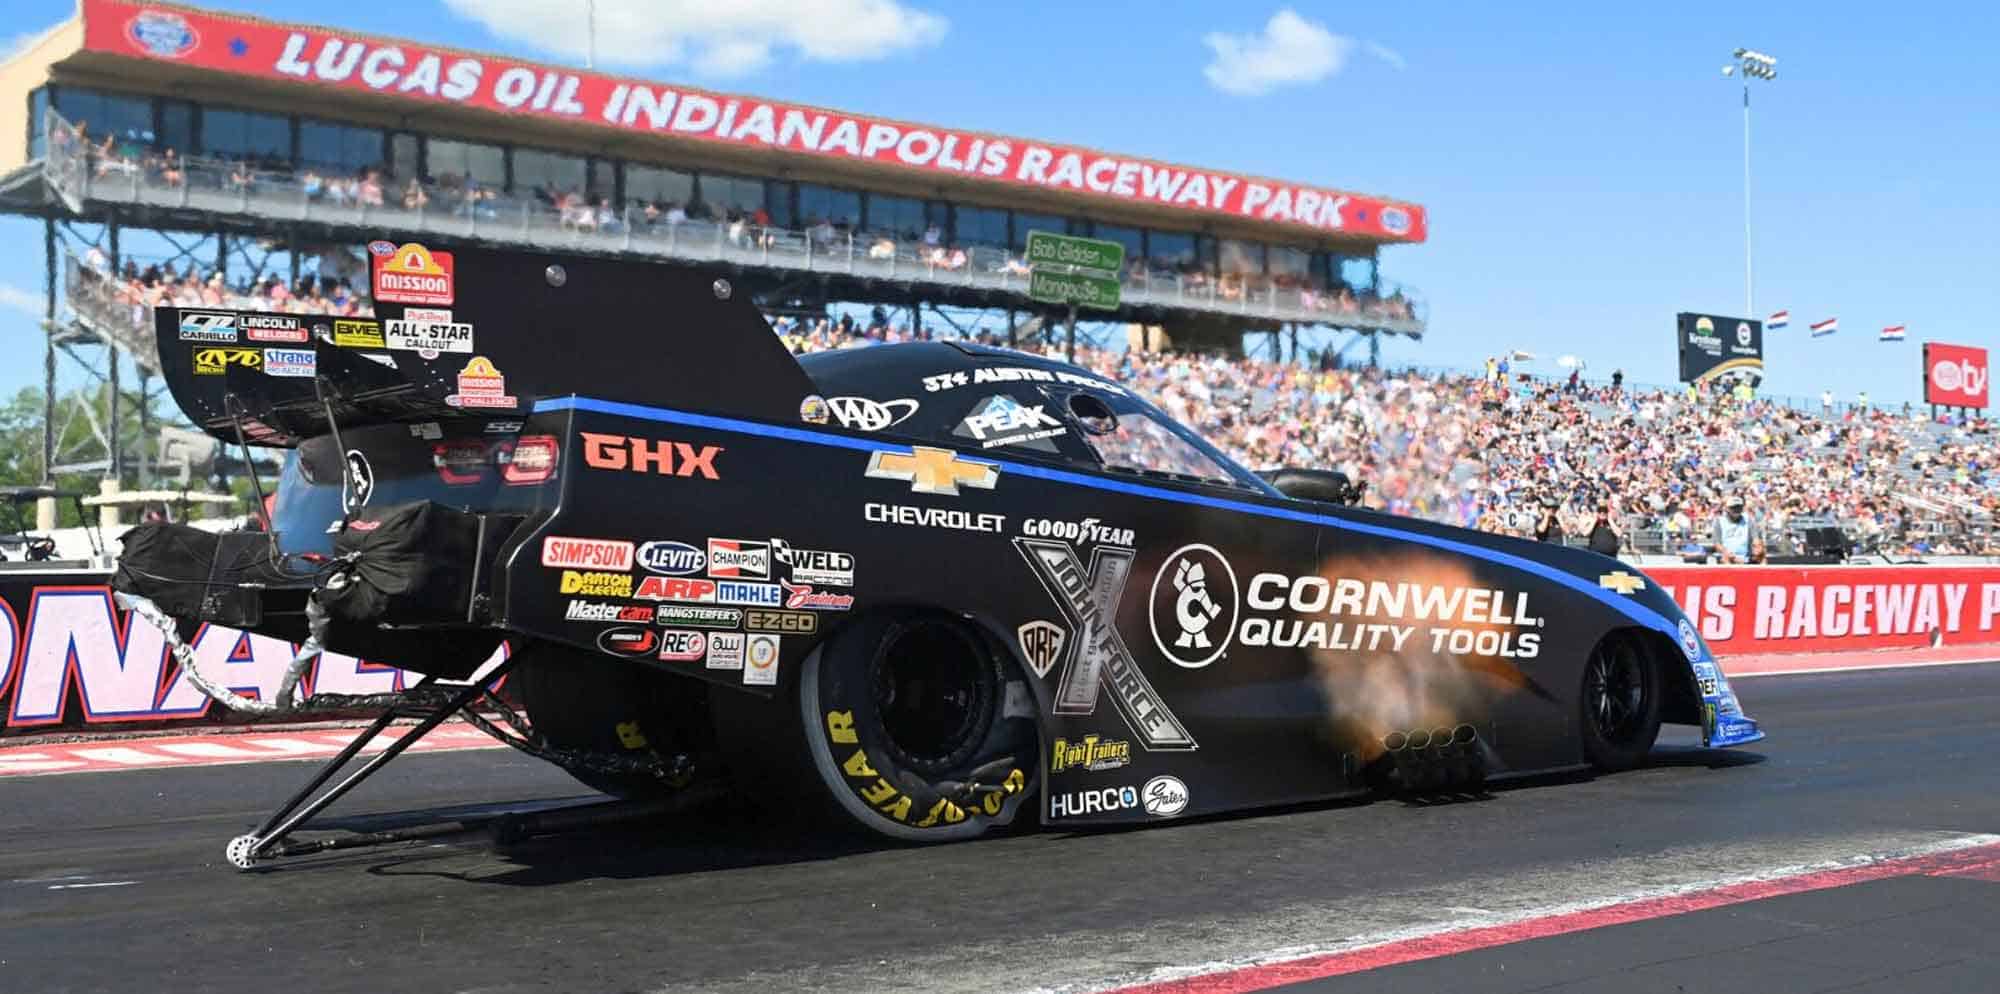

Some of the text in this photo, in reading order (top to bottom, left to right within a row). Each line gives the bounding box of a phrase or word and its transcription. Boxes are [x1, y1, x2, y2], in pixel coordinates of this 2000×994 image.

[274, 33, 1349, 229] LUCAS OIL INDIANAPOLIS RACEWAY PARK
[240, 317, 297, 329] LINCOLN
[337, 323, 380, 336] BME
[405, 339, 451, 349] CALLOUT
[964, 405, 1063, 440] PEAK
[580, 432, 725, 480] GHX
[864, 503, 1006, 533] CHEVROLET
[1022, 518, 1136, 547] GOODYEAR
[549, 541, 628, 567] SIMPSON
[712, 551, 767, 567] CHAMPION
[791, 550, 853, 571] WELD
[638, 577, 715, 599] ARP
[719, 583, 780, 604] MAHLE
[1047, 557, 1107, 638] JOHN
[1247, 573, 1539, 627] CORNWELL
[566, 600, 653, 620] Mastercam
[660, 606, 739, 620] HANGSTERFER'S
[1662, 585, 1737, 640] IS
[1753, 584, 1968, 640] RACEWAY
[1239, 618, 1542, 658] QUALITY TOOLS
[1098, 634, 1167, 733] FORCE
[1051, 786, 1139, 818] HURCO
